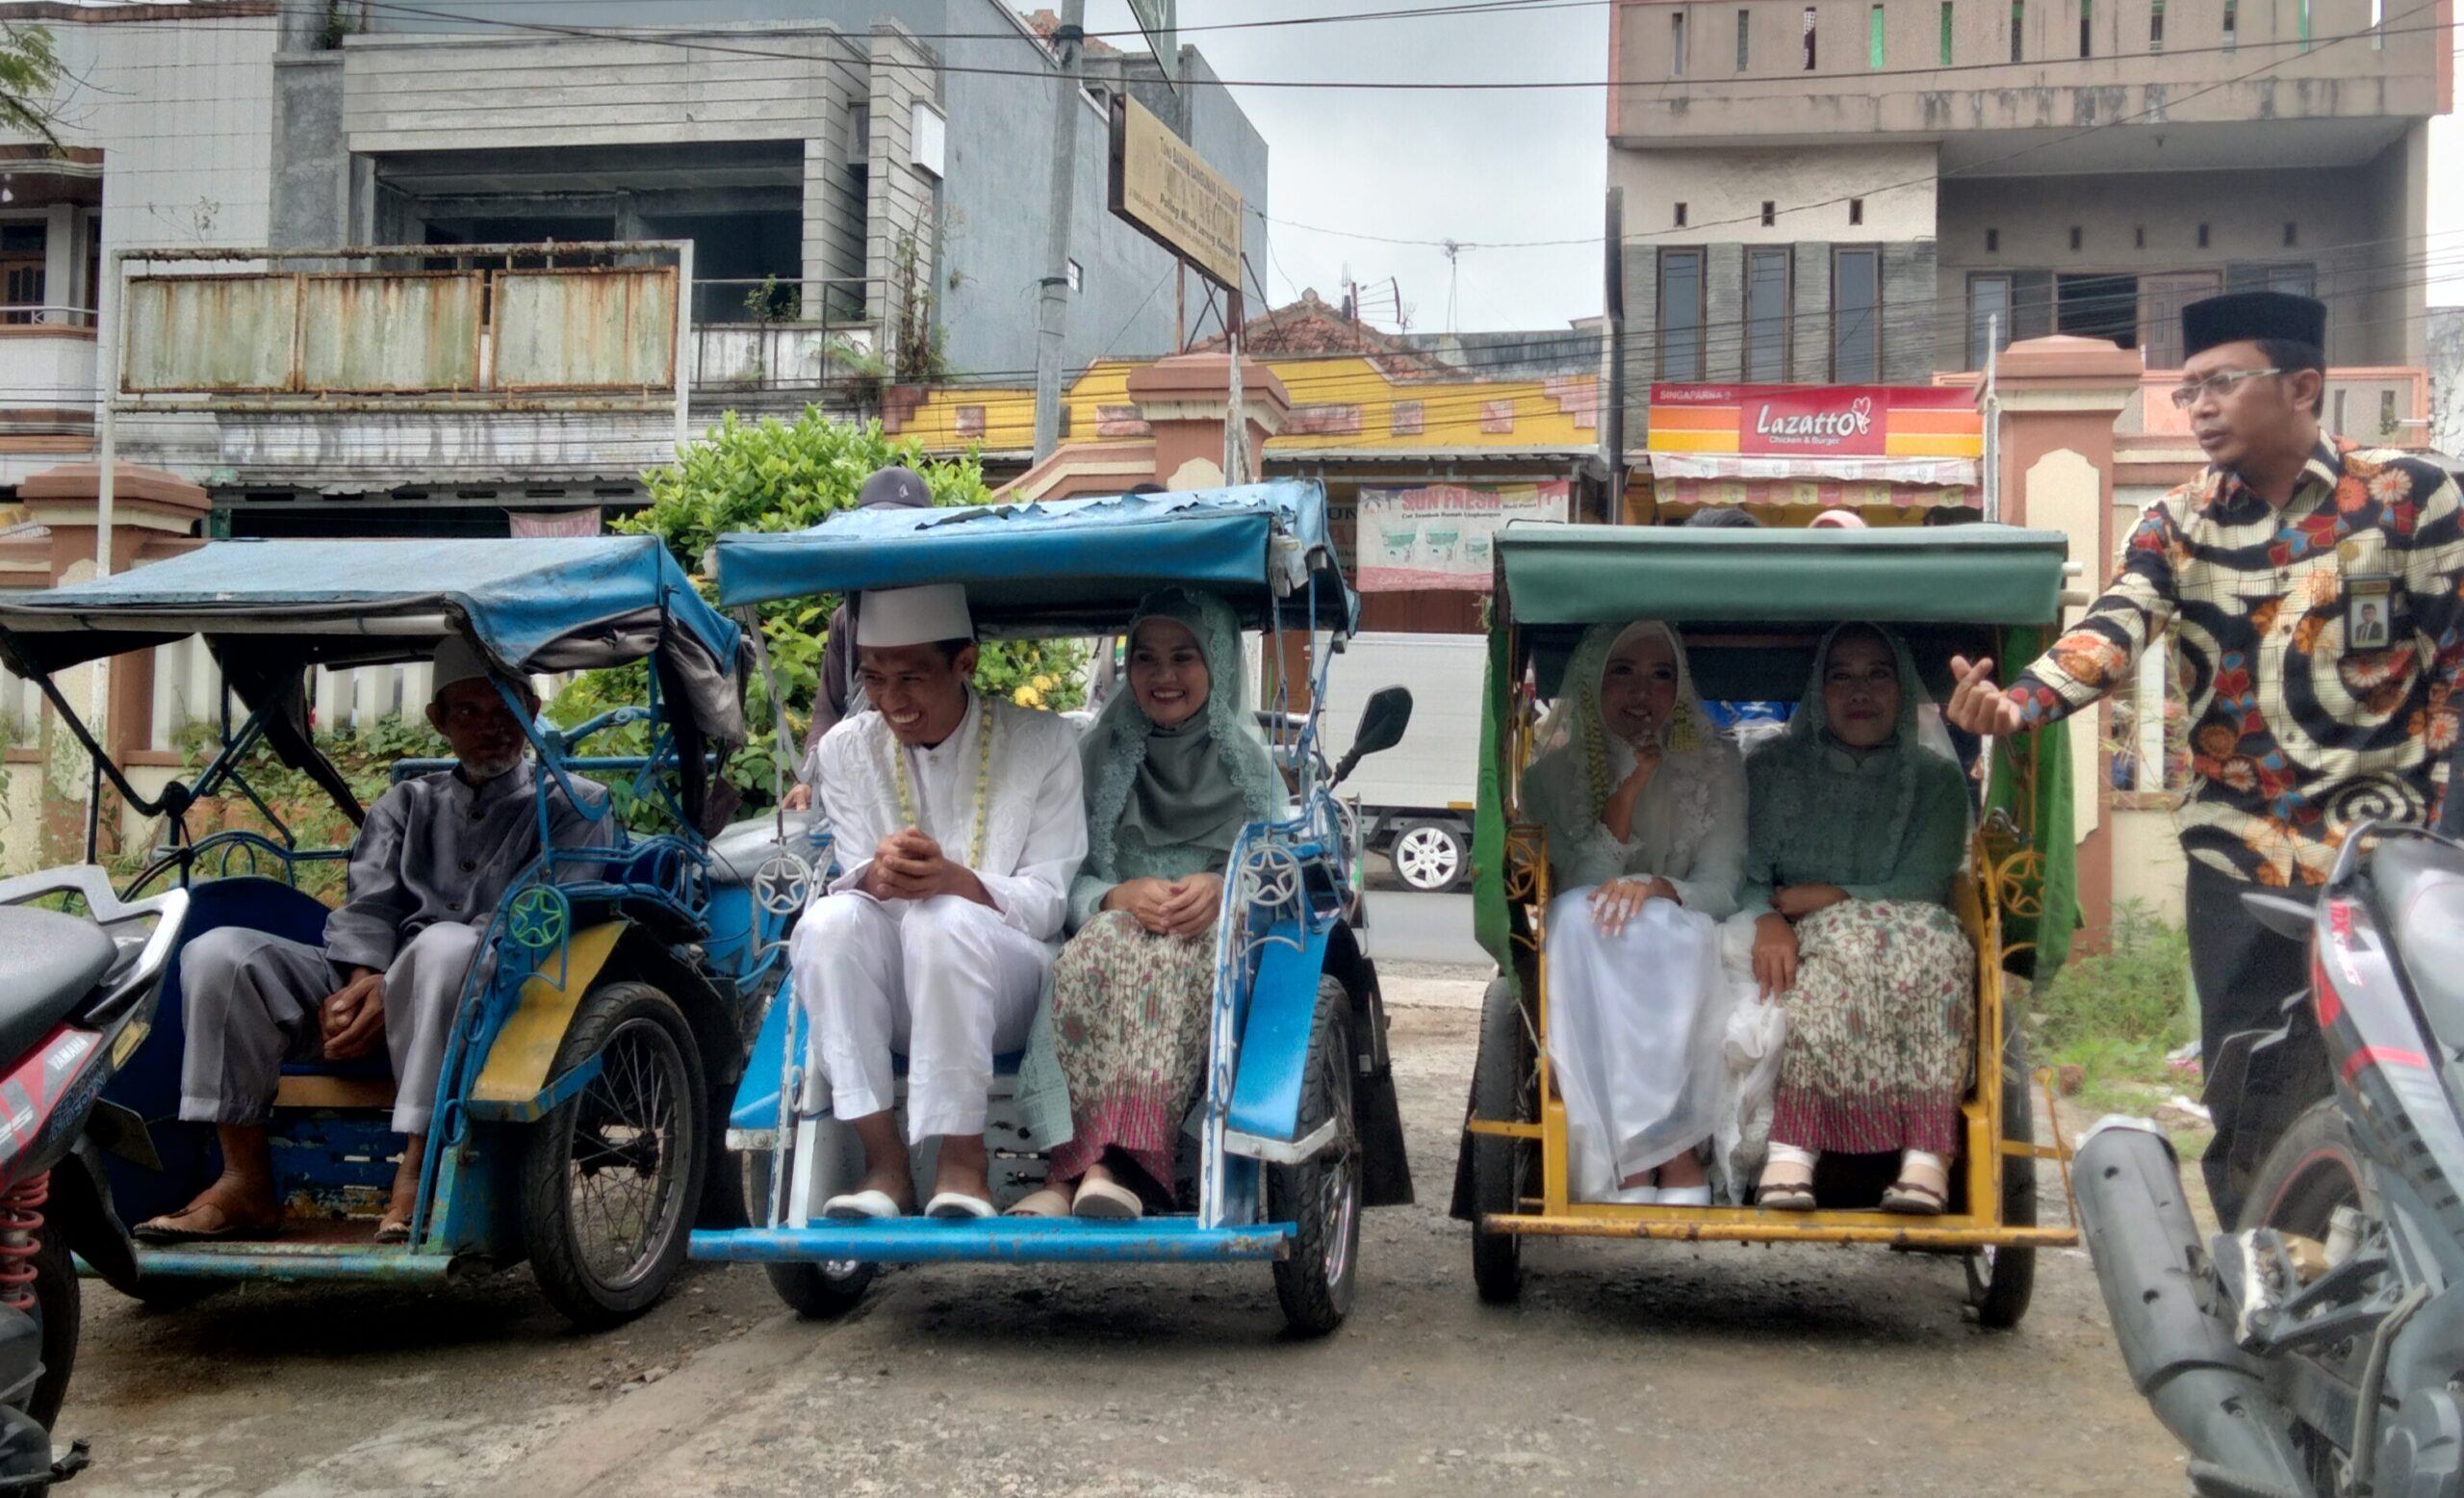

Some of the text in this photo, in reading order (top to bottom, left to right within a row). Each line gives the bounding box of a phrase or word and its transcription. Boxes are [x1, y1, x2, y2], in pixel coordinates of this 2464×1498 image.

[1660, 391, 1722, 400] SINGAPARNA
[1757, 404, 1856, 436] Lazatto
[1769, 435, 1802, 444] Chicken
[1811, 437, 1840, 446] Burger
[1401, 489, 1501, 510] SUN FRESH
[46, 1036, 89, 1071] YAMAHA
